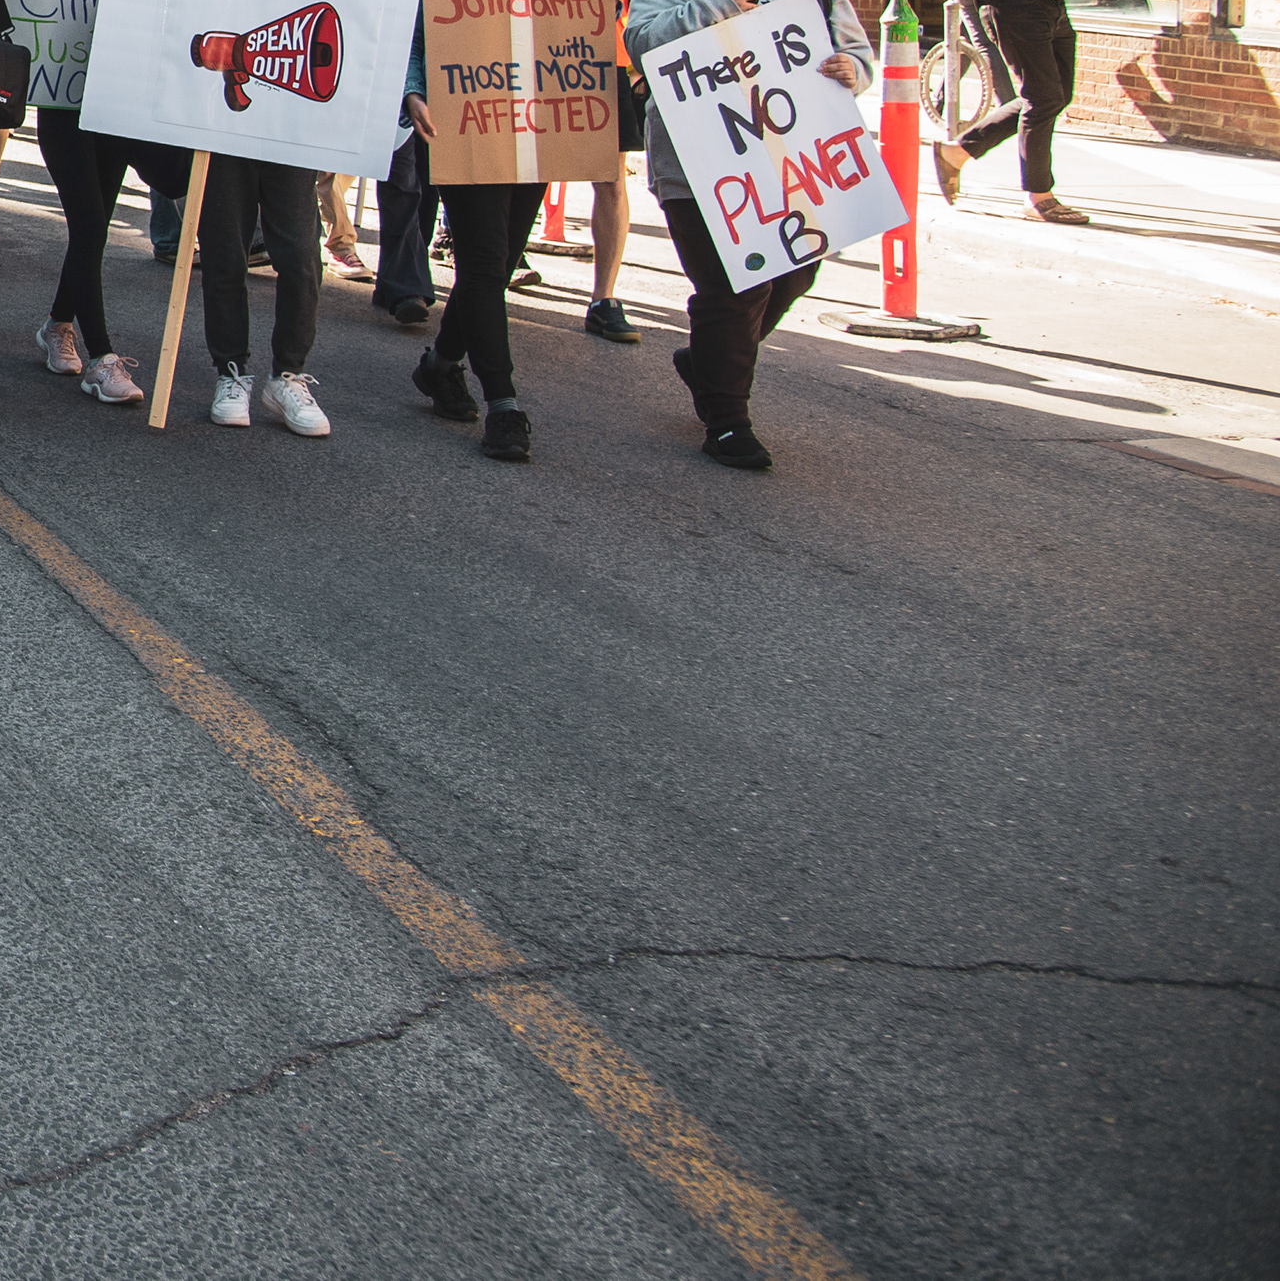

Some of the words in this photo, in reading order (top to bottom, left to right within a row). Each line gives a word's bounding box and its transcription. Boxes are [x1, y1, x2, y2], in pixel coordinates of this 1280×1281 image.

[245, 12, 315, 53] SPEAK
[548, 35, 595, 60] with
[251, 55, 306, 90] OUT!
[441, 62, 522, 95] THOSE
[535, 59, 613, 93] MOST
[659, 47, 762, 102] There
[458, 95, 611, 136] AFFECTED
[718, 84, 797, 156] NO
[713, 126, 872, 245] PLANET
[778, 211, 829, 267] B
